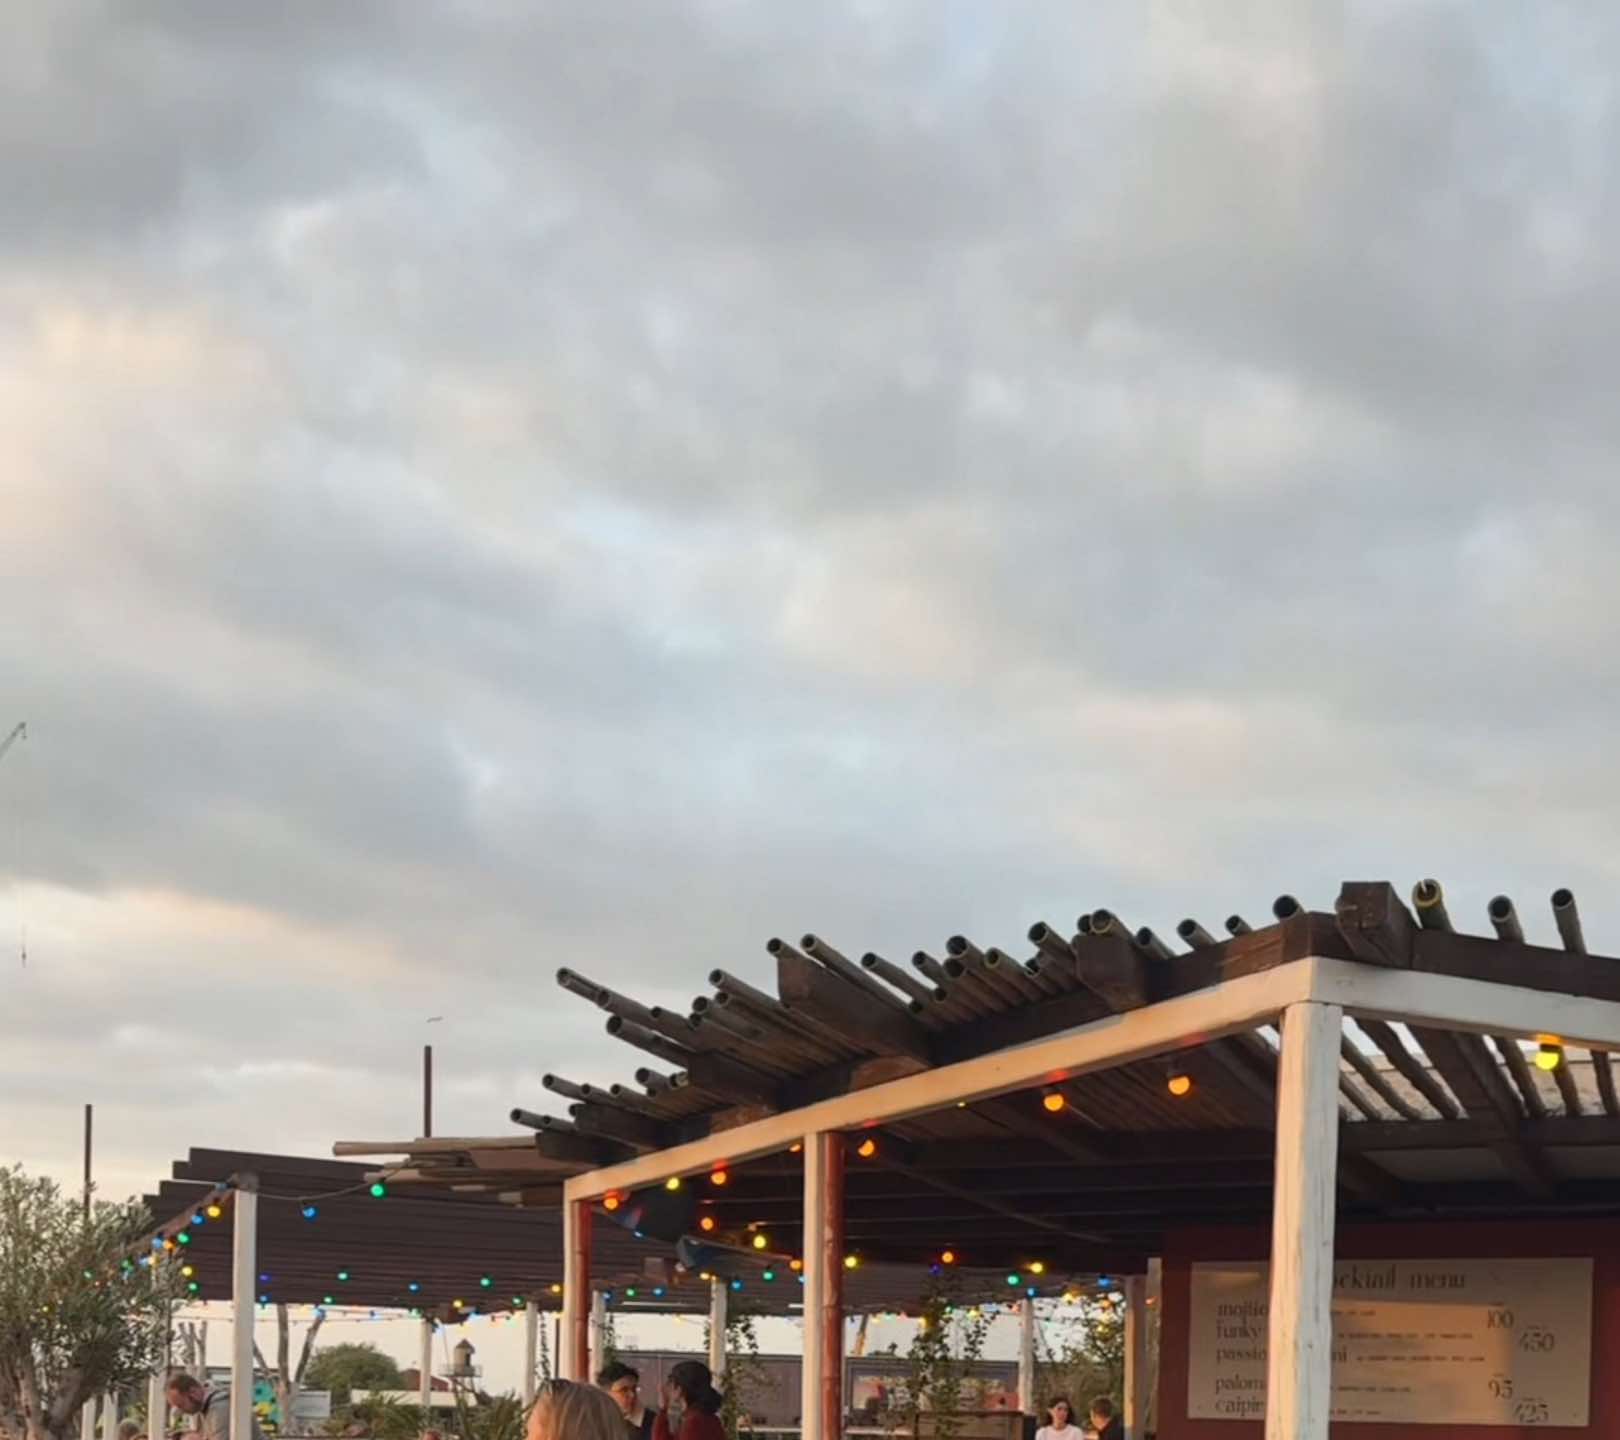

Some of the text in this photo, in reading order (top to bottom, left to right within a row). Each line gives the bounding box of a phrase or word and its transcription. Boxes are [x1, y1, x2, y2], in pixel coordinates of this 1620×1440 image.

[1333, 1263, 1396, 1289] cktail
[1216, 1318, 1261, 1342] funky
[1216, 1345, 1267, 1365] passio
[1215, 1373, 1266, 1395] palom
[1487, 1378, 1514, 1400] 95
